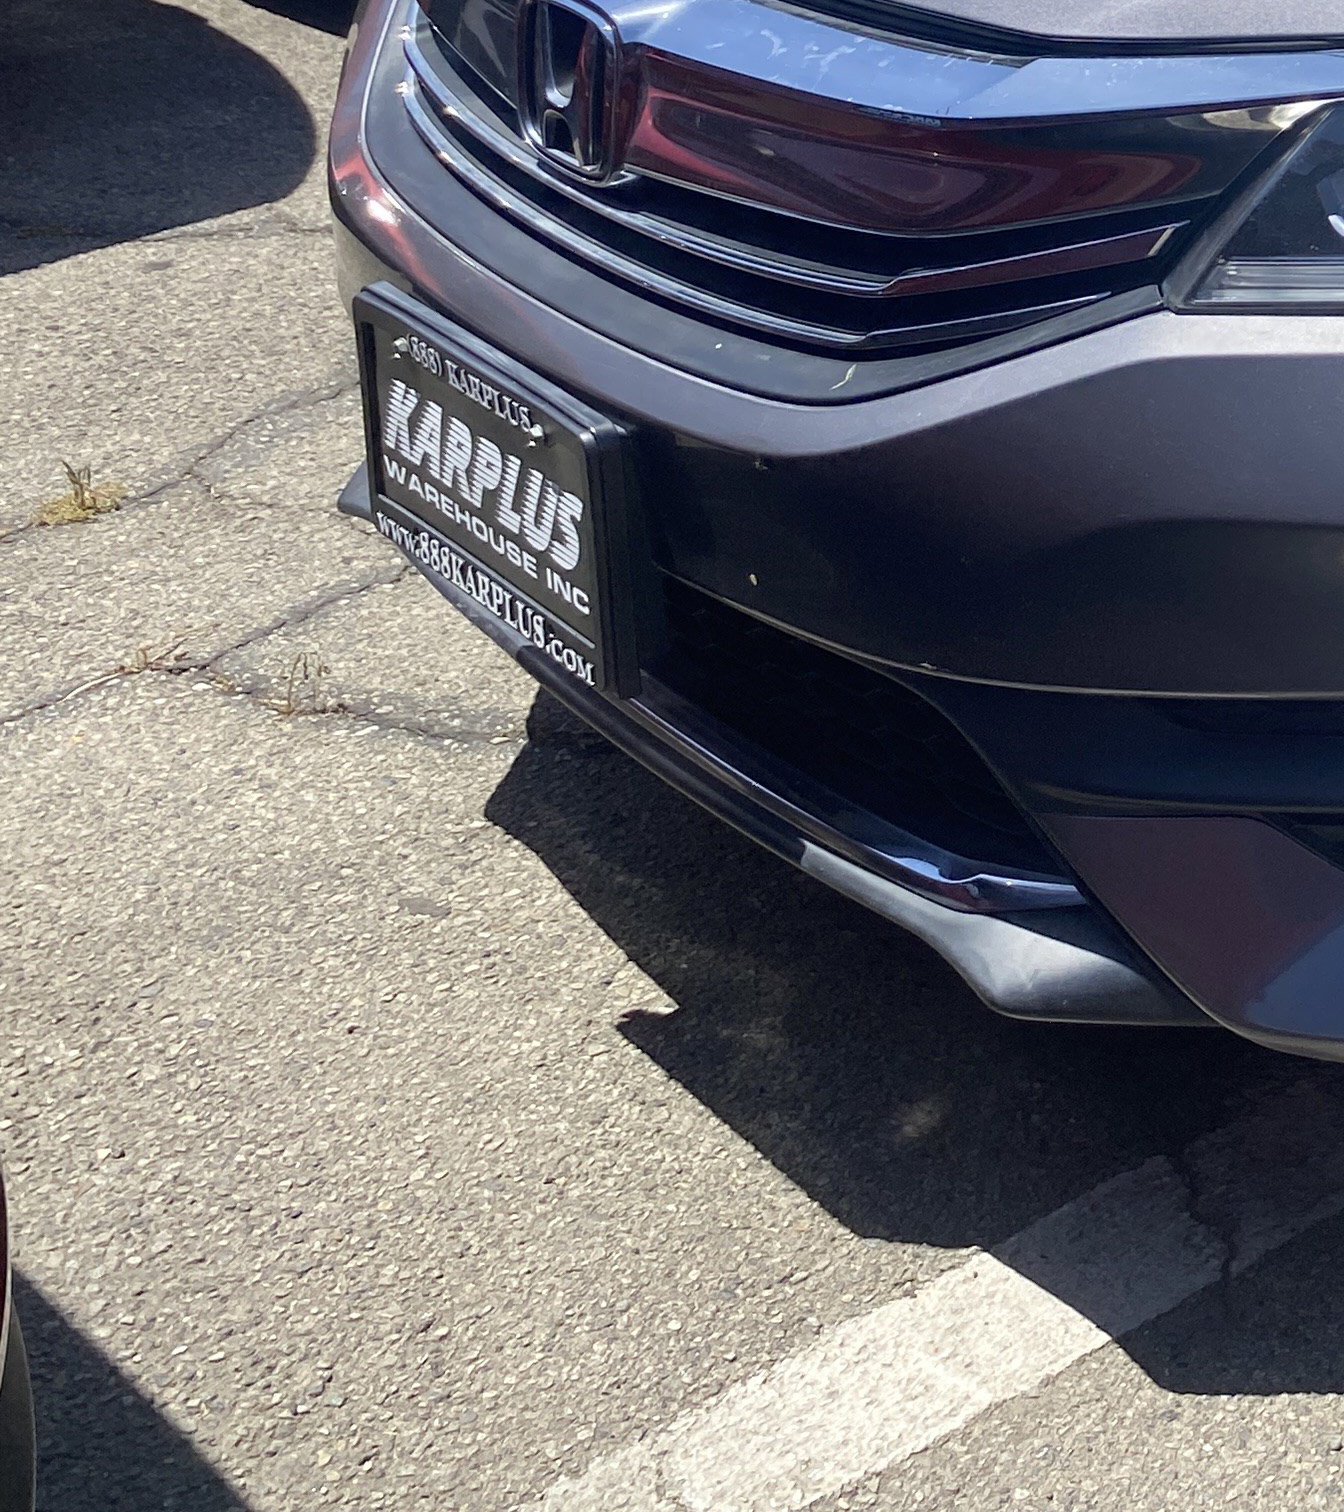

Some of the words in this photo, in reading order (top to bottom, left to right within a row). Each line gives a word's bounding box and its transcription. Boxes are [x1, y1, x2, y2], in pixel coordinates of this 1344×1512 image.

[408, 334, 443, 377] (888)
[445, 359, 532, 433] KARPLUS
[383, 455, 539, 579] WAREHOUSE
[546, 567, 591, 616] INC
[384, 378, 584, 571] KARPLUS
